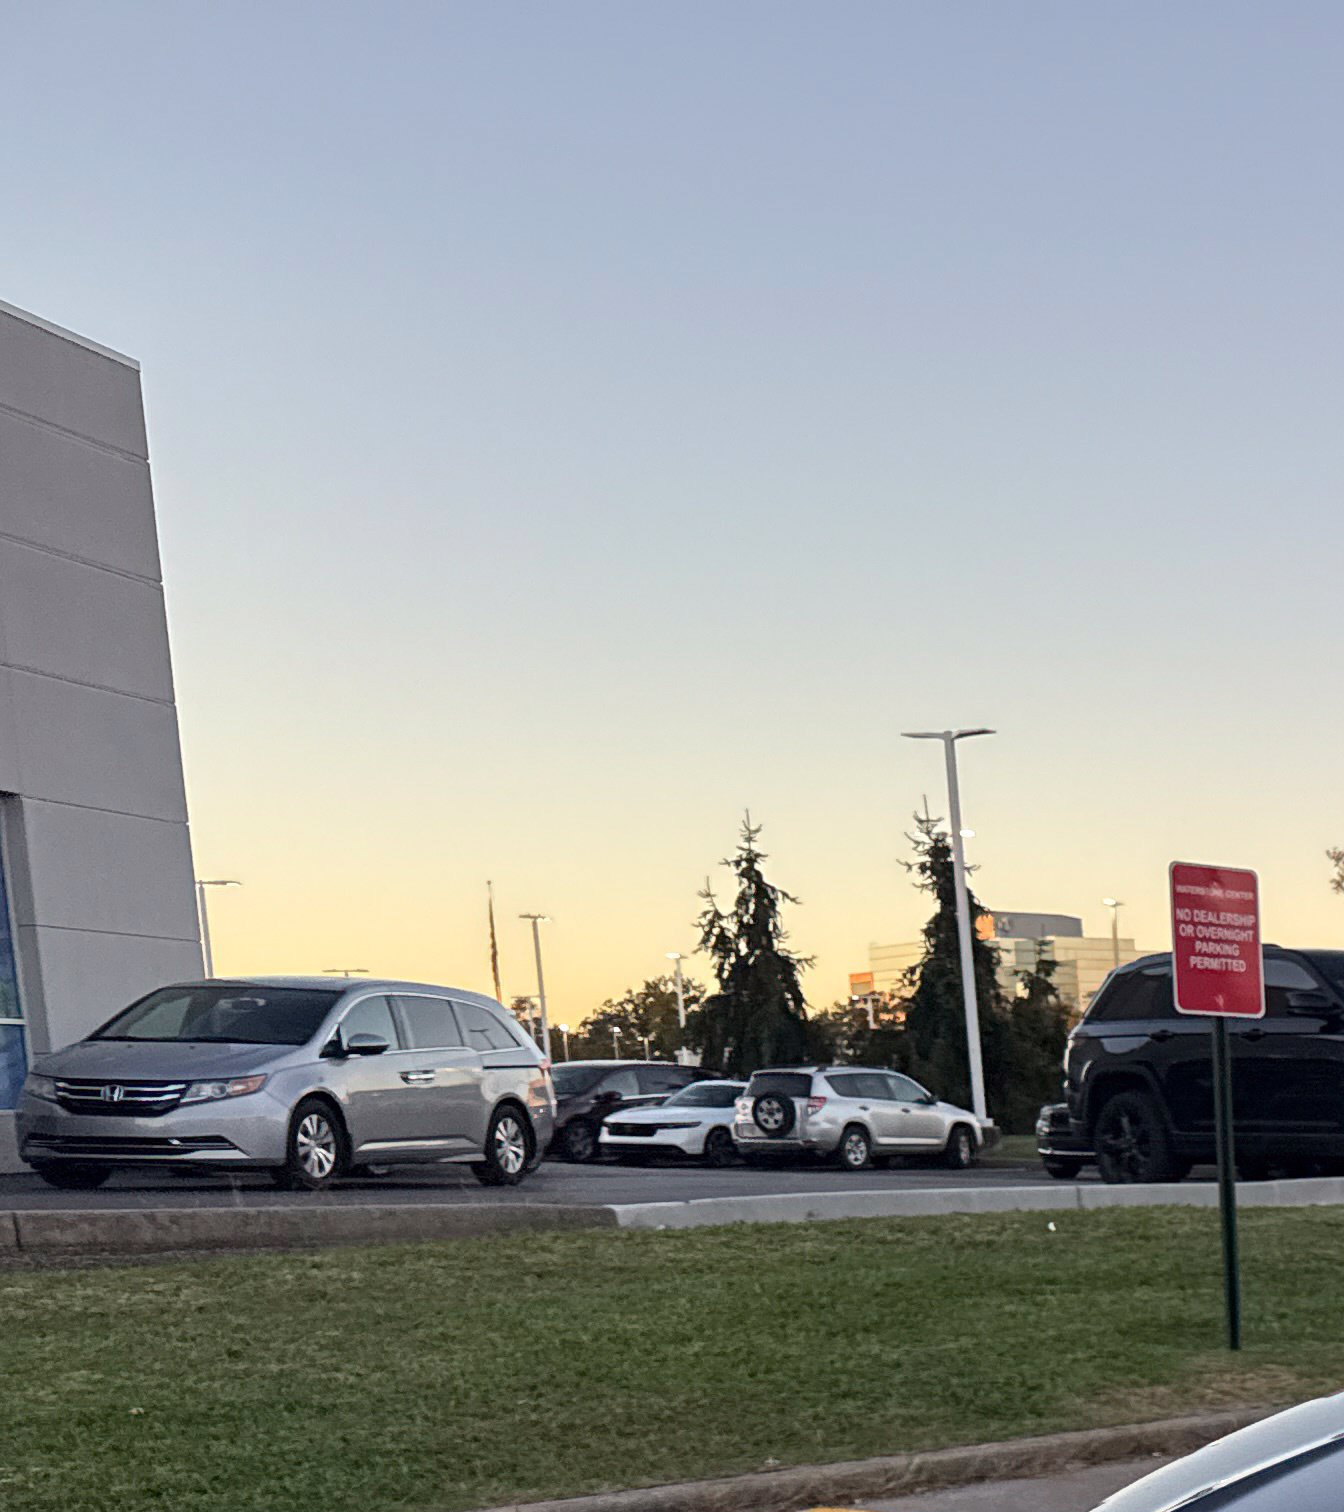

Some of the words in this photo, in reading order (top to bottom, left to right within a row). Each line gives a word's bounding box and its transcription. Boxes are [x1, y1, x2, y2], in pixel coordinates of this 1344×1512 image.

[1176, 908, 1191, 921] NO
[1193, 909, 1256, 926] DEALERSHIP
[1180, 923, 1195, 937] OR
[1196, 925, 1254, 942] OVERNIGHT
[1195, 941, 1240, 956] PARKING
[1190, 955, 1246, 972] PERMITTED
